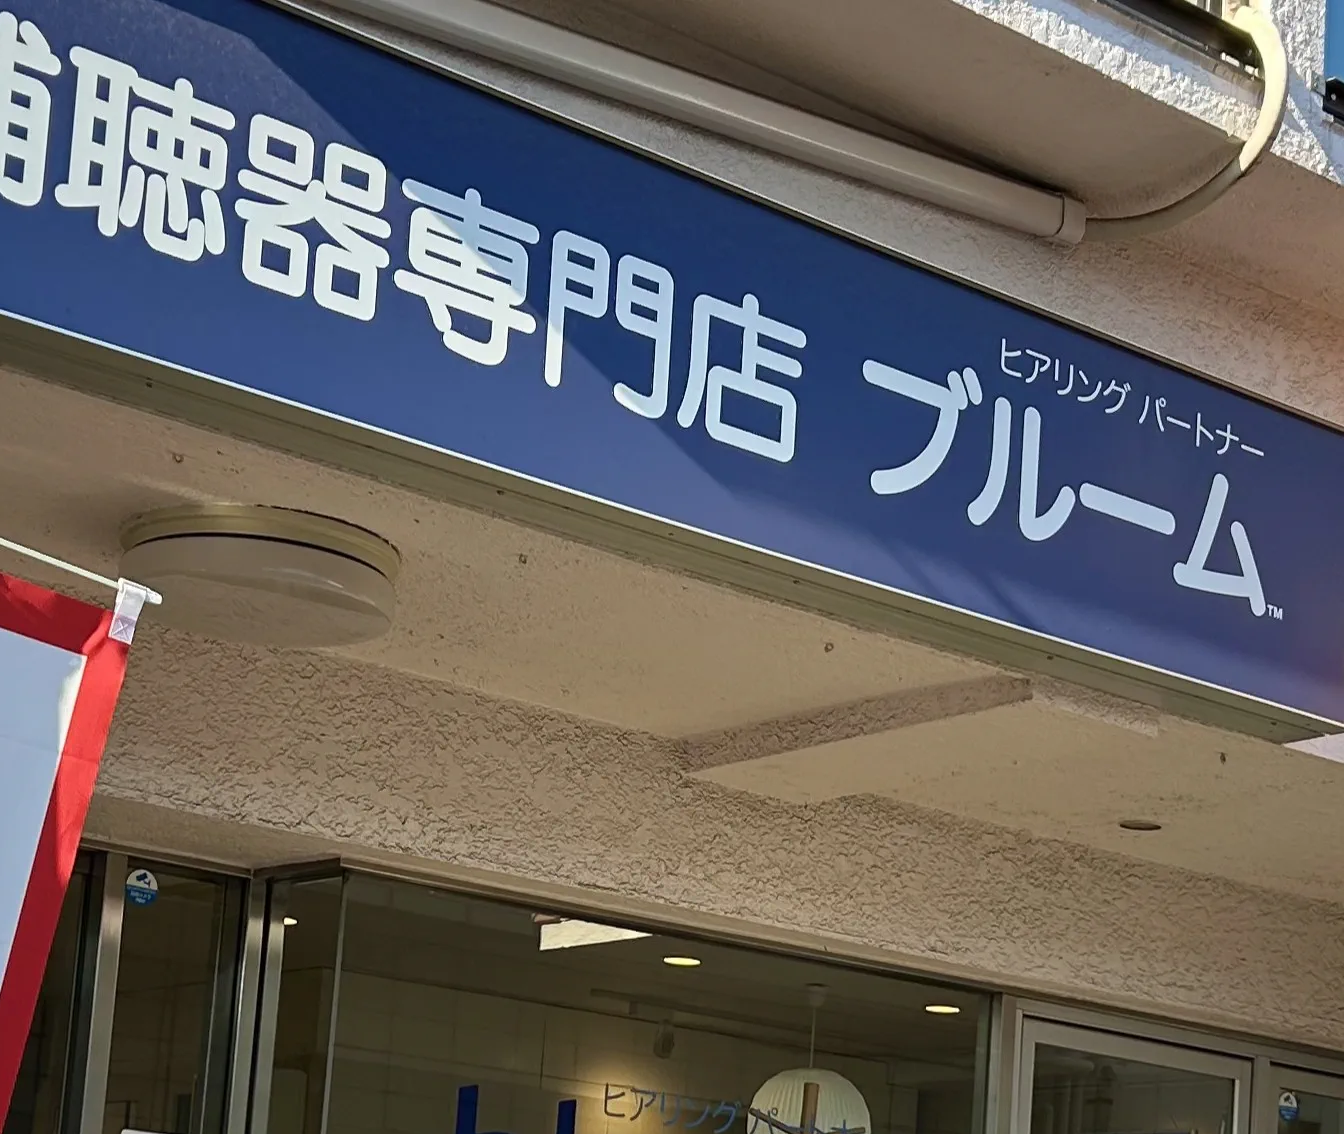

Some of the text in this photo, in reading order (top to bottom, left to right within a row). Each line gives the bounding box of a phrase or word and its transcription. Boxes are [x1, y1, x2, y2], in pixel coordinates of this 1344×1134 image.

[999, 338, 1265, 457] ヒアリング パートナー
[862, 359, 1267, 617] ブルーム
[605, 1082, 742, 1134] ヒアリング
